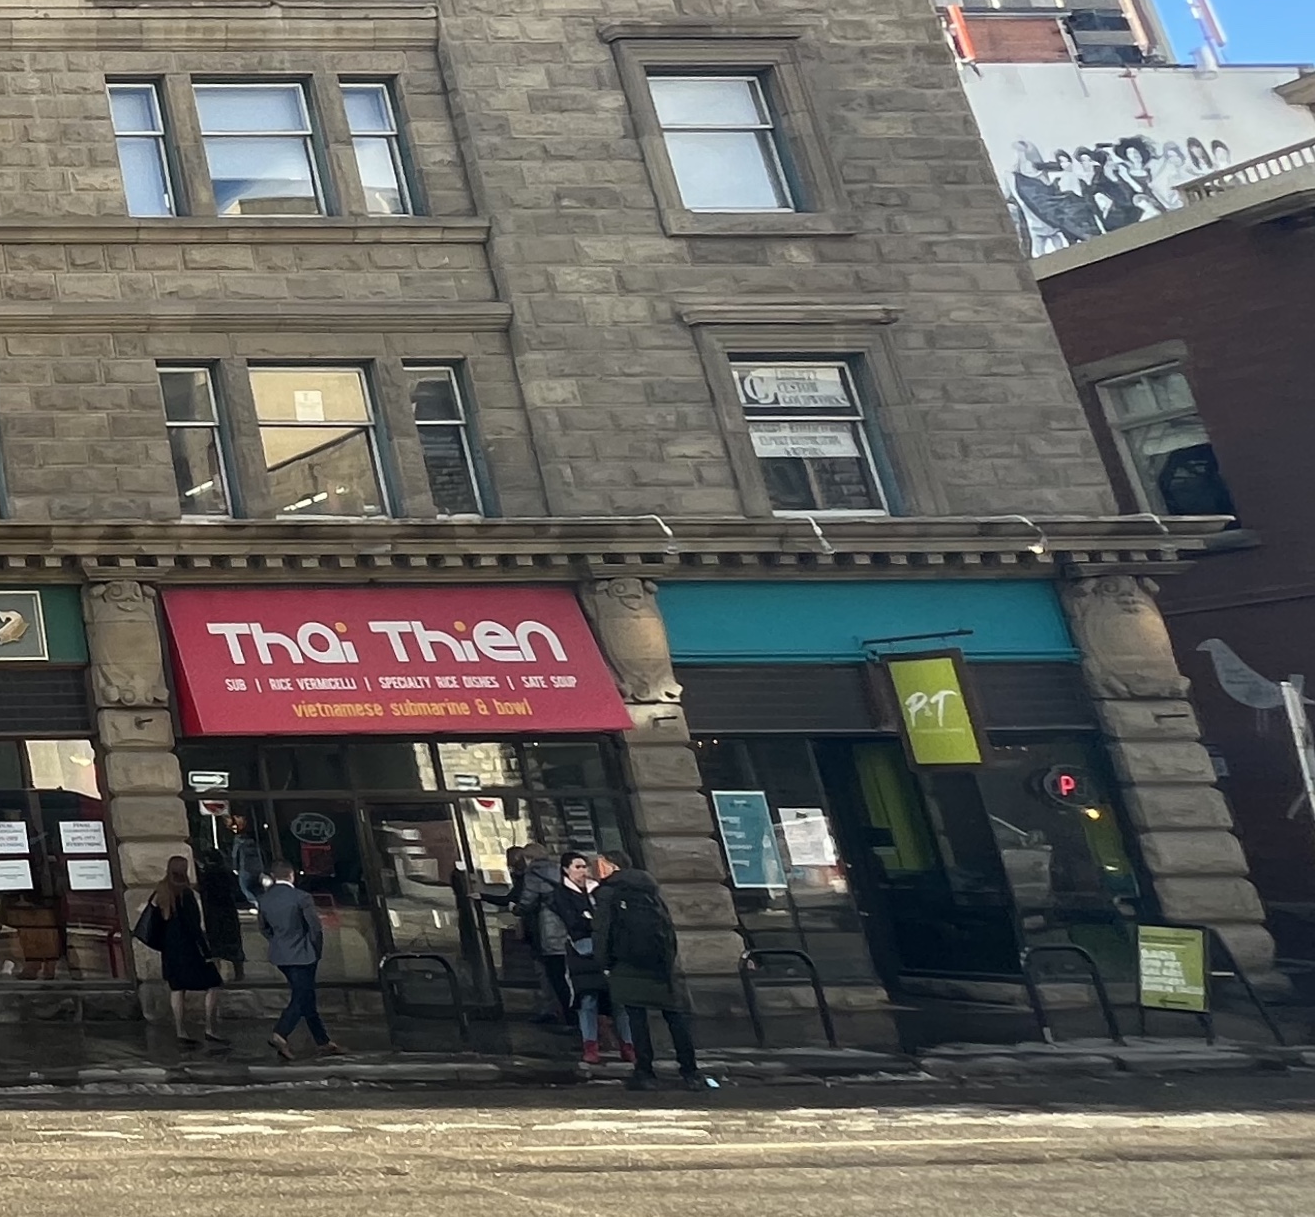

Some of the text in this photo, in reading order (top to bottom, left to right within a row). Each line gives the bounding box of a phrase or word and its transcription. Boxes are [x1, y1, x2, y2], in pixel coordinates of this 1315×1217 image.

[206, 620, 568, 664] Thai Thien
[225, 675, 577, 691] SUB RICE VERMICELLI SPECIALTY RICE DISHES SATE SOUP
[291, 698, 533, 717] vietnamese submarine & bowl
